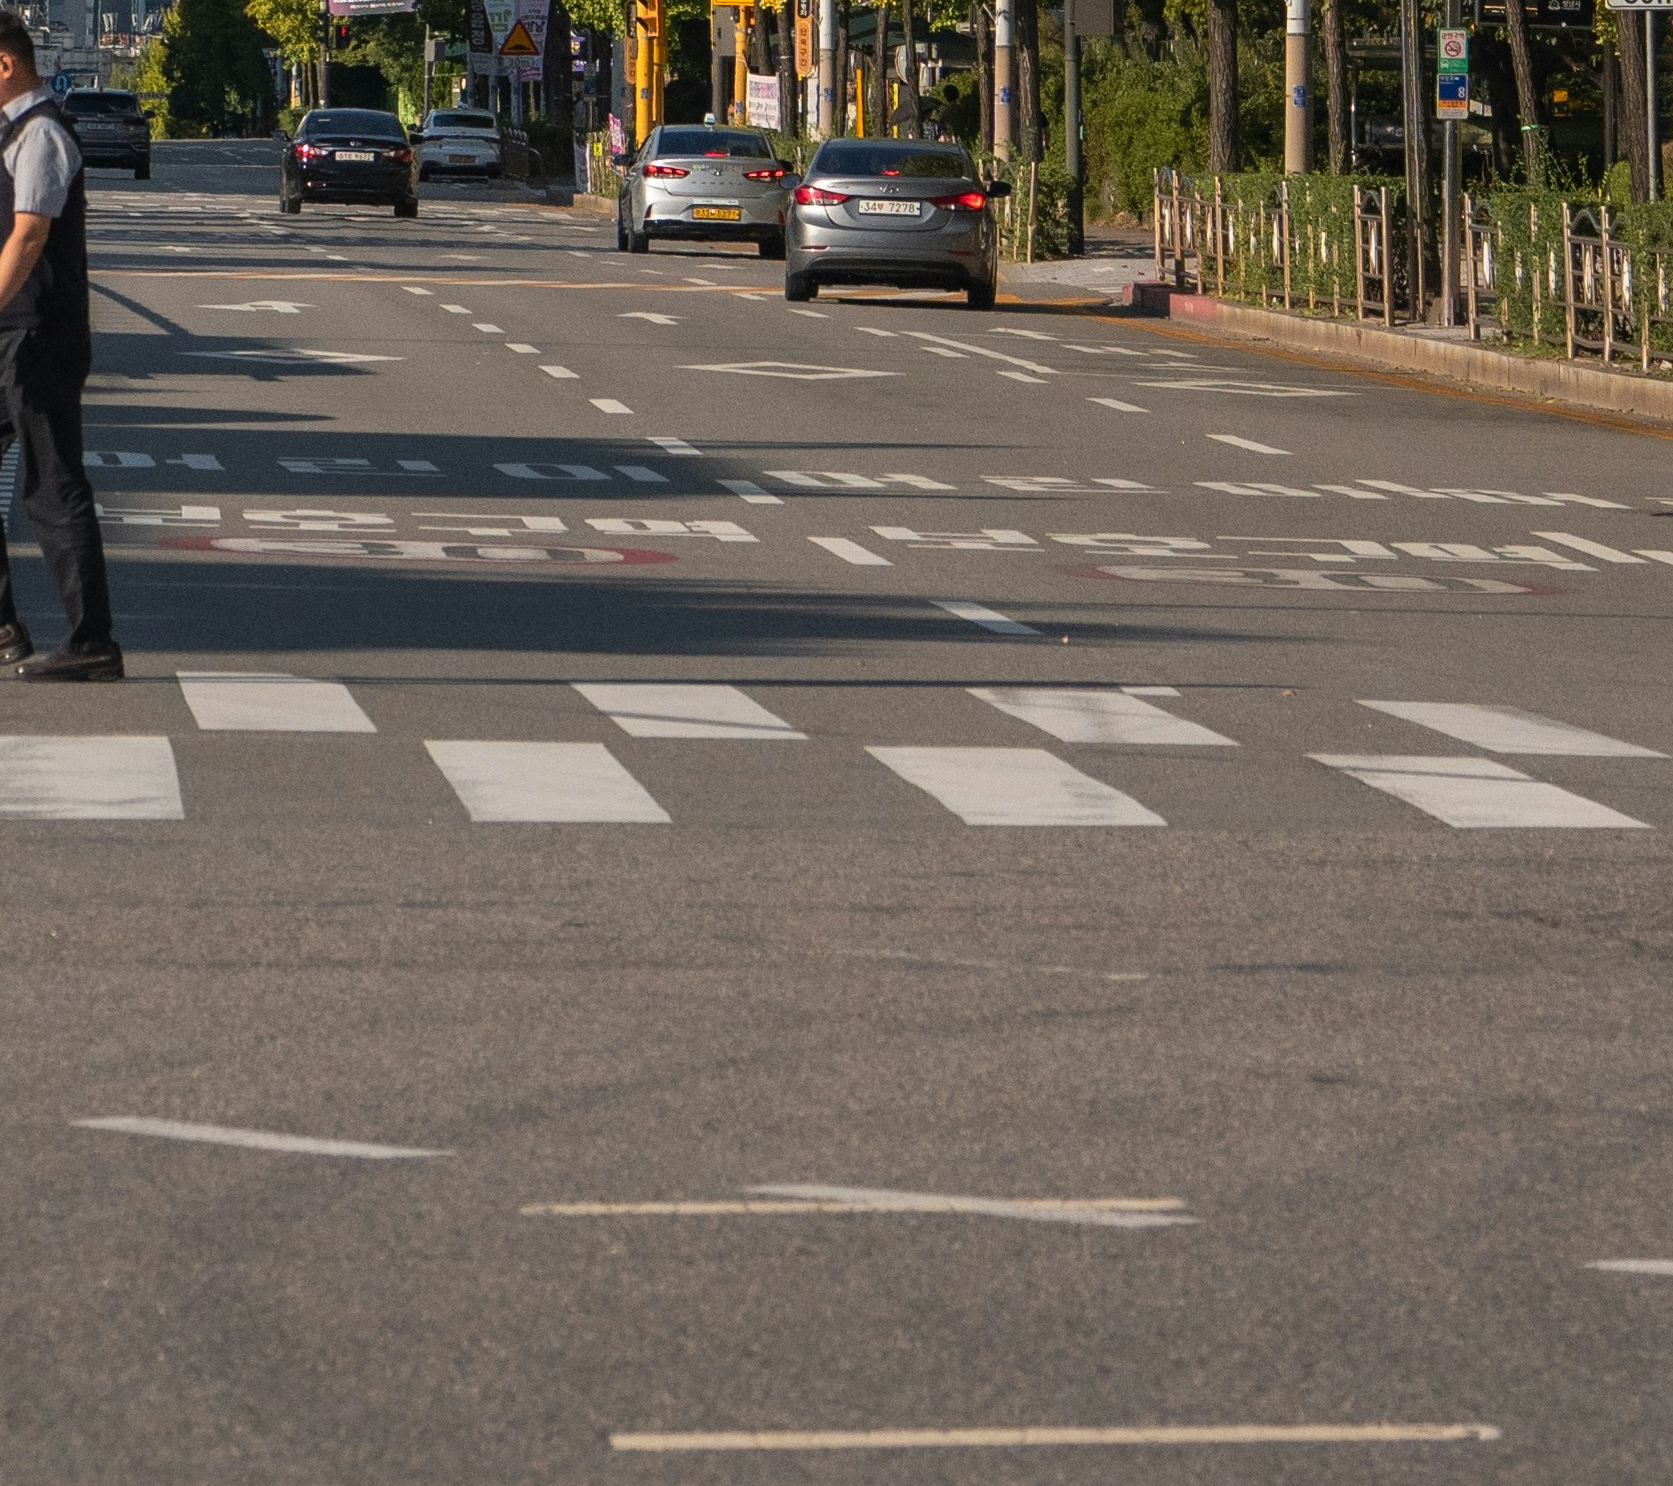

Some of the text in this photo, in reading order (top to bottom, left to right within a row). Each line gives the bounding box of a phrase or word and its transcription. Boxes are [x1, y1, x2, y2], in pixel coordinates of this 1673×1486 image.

[1457, 86, 1466, 99] 8
[889, 203, 916, 214] 7278
[1133, 567, 1483, 592] 30
